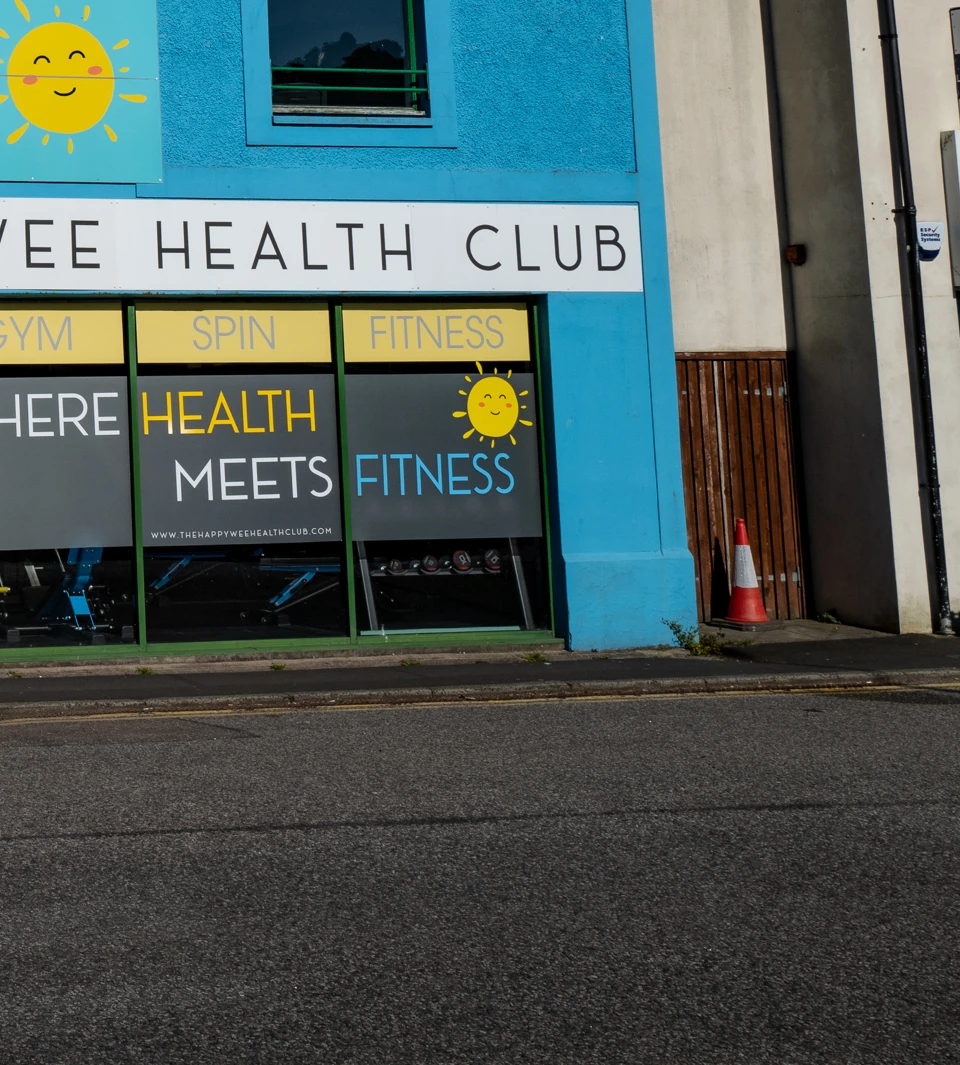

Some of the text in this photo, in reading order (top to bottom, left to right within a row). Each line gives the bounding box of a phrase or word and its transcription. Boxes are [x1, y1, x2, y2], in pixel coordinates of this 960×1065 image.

[157, 221, 412, 270] HEALTH
[466, 225, 625, 271] CLUB
[193, 315, 275, 350] SPIN
[371, 315, 504, 349] FITNESS
[142, 390, 315, 434] HEALTH
[175, 453, 514, 501] MEETS FITNESS
[149, 526, 333, 540] WWW.THEHAPPYWEEHEALTHCLUB.COM
